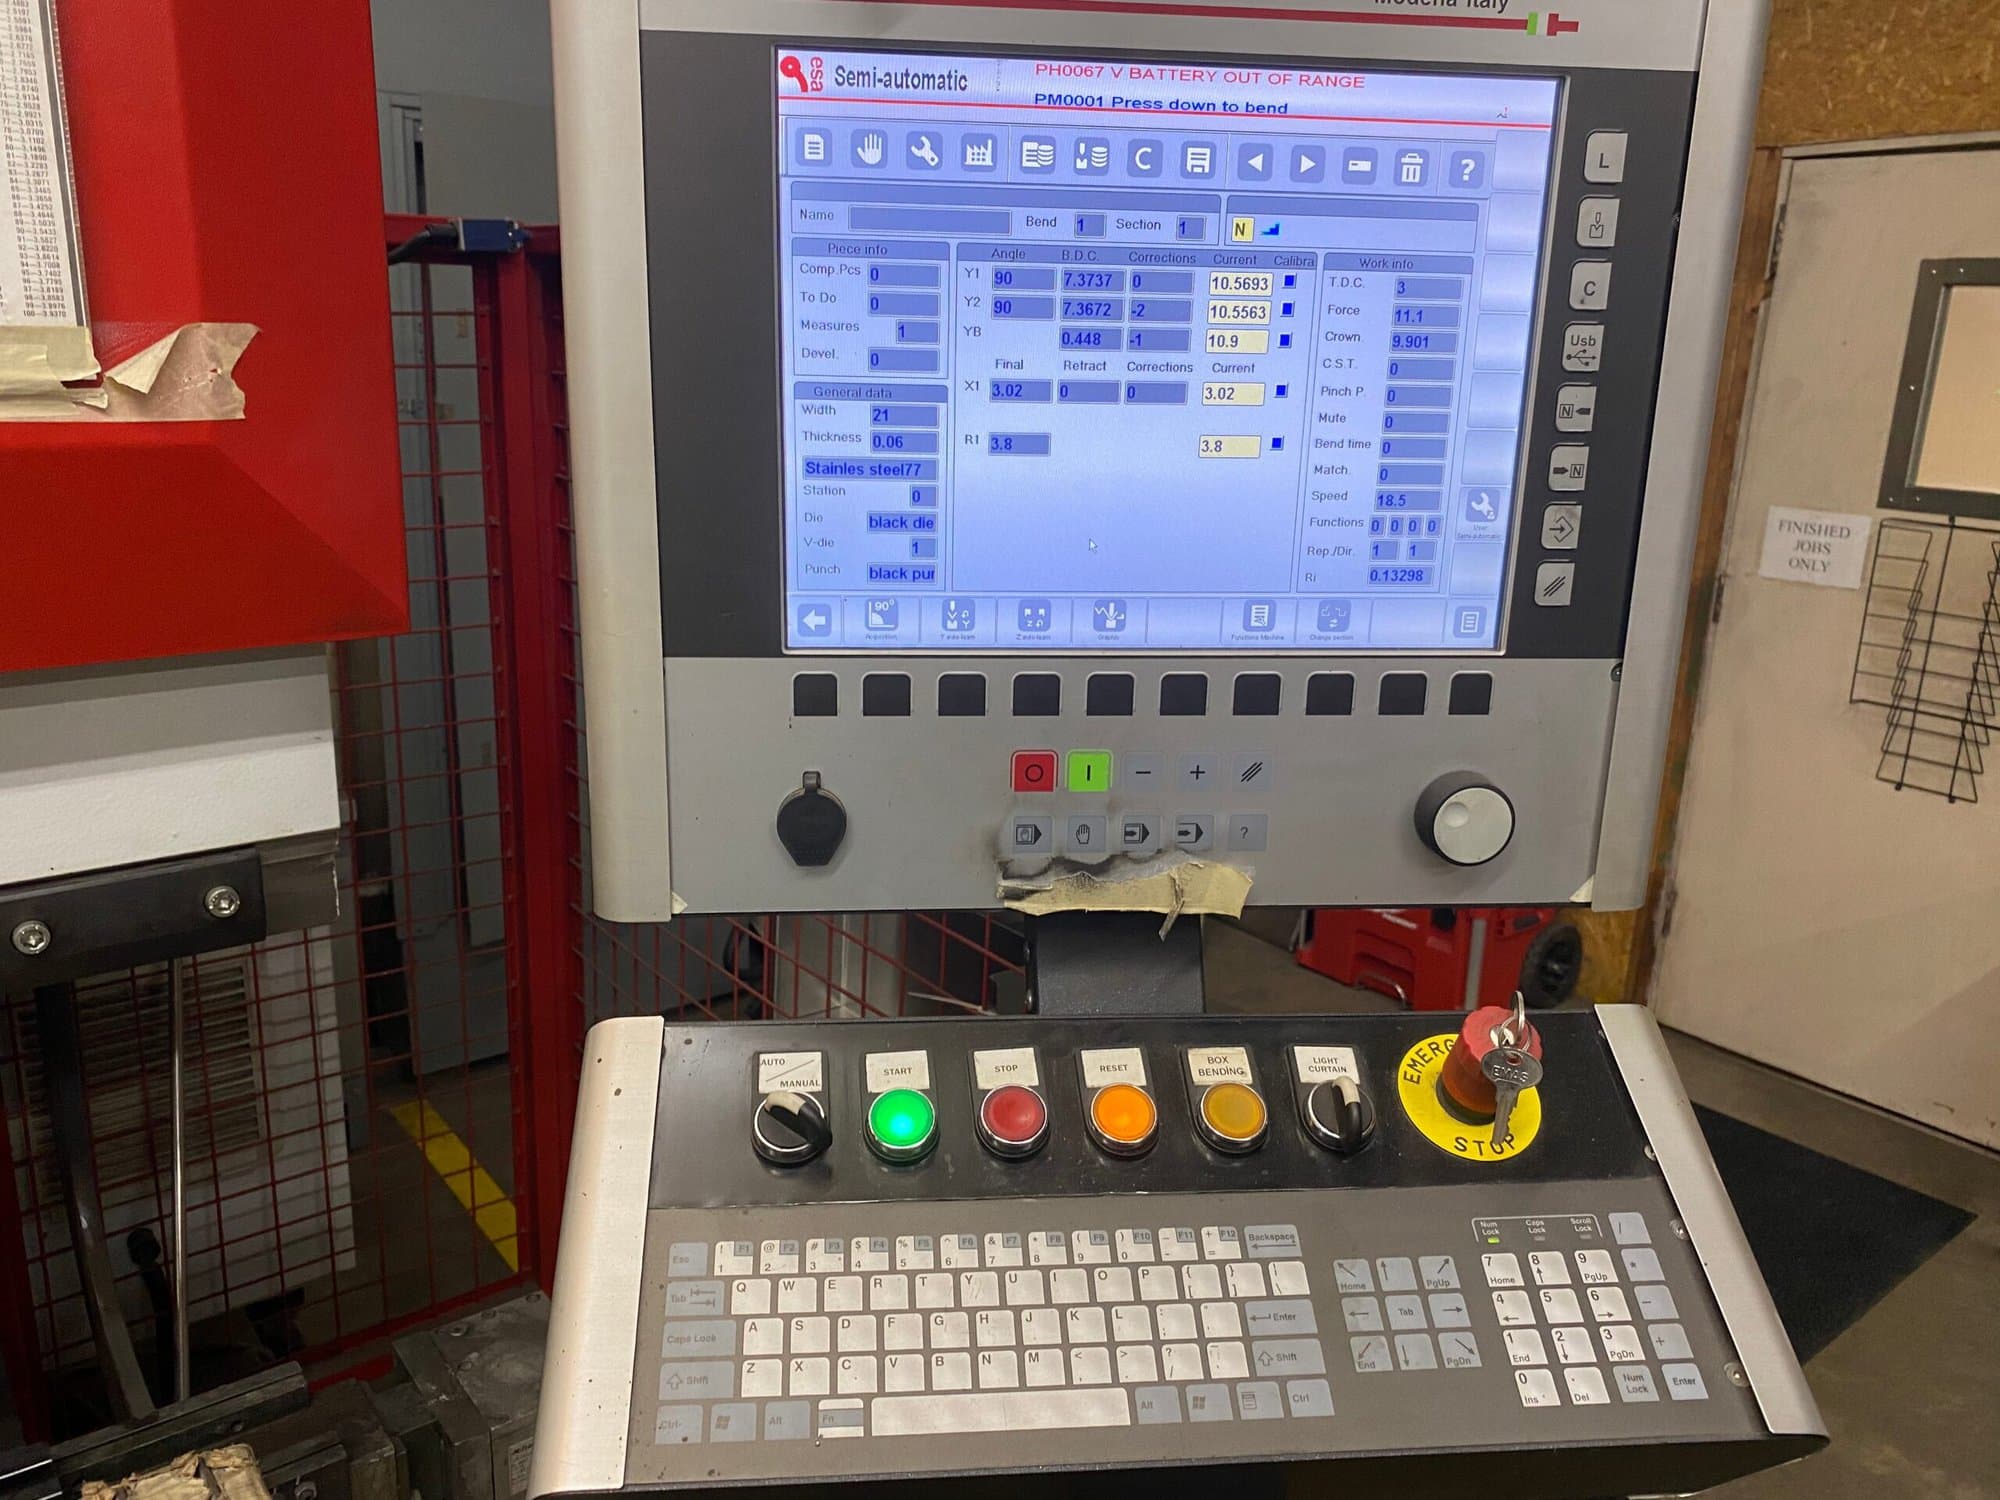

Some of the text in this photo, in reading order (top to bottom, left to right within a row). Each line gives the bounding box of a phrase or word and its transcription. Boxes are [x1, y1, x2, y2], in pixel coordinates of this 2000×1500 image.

[810, 56, 823, 92] esa
[835, 65, 968, 91] Semi-automatic
[1036, 64, 1365, 88] PH0067 V BATTERY OUT OF RANGE
[1035, 93, 1287, 115] PM0001 Press down to bend
[1599, 153, 1610, 169] L
[800, 209, 834, 221] Name
[1026, 216, 1056, 228] Bend
[1077, 218, 1085, 233] 1
[1116, 218, 1161, 231] Section
[1179, 222, 1186, 235] 1
[1235, 224, 1245, 237] N
[828, 243, 887, 255] Piece info
[991, 248, 1025, 260] Angle
[1128, 251, 1196, 265] Corrections
[1214, 254, 1257, 265] Current
[1274, 256, 1315, 267] Calibra
[1359, 258, 1413, 269] Work info
[870, 268, 879, 281] 0
[965, 267, 980, 279] Y1
[994, 271, 1012, 285] 90
[1065, 272, 1112, 287] 7.3737
[1133, 274, 1141, 288] 0
[1212, 276, 1268, 290] 10.5693
[1397, 281, 1405, 294] 3
[1584, 281, 1596, 296] C
[801, 292, 836, 303] To Do
[870, 297, 879, 310] 0
[964, 297, 981, 308] Y2
[994, 300, 1011, 314] 90
[1064, 302, 1111, 316] 7.3672
[1132, 304, 1145, 317] -2
[1210, 305, 1266, 319] 10.5563
[1328, 304, 1360, 315] Force
[1395, 309, 1423, 322] 11.1
[801, 320, 859, 332] Measures
[899, 325, 905, 338] 1
[963, 326, 981, 337] YB
[1062, 332, 1101, 345] 0.448
[1129, 333, 1141, 346] -1
[1209, 335, 1238, 348] 10.9
[1392, 335, 1429, 349] 9.901
[1570, 335, 1596, 347] Usb
[871, 353, 879, 366] 0
[995, 359, 1024, 370] Final
[1064, 360, 1107, 371] Retract
[1127, 362, 1193, 373] Corrections
[1212, 362, 1255, 373] Current
[1390, 363, 1398, 375] 0
[965, 380, 979, 391] X1
[992, 384, 1022, 397] 3.02
[1060, 385, 1068, 398] 0
[1321, 386, 1351, 397] Pinch
[814, 387, 892, 398] General data
[1127, 386, 1135, 399] 0
[1205, 387, 1235, 400] 3.02
[1387, 390, 1396, 402] 0
[802, 404, 836, 416] Width
[873, 409, 889, 422] 21
[1562, 406, 1571, 417] N
[1319, 413, 1346, 423] Mute
[1385, 416, 1393, 428] 0
[802, 431, 861, 443] Thickness
[873, 436, 903, 448] 0.06
[965, 434, 979, 444] R1
[991, 437, 1012, 451] 3.8
[1201, 440, 1222, 452] 3.8
[1315, 439, 1371, 449] Bend time
[1382, 442, 1390, 454] 0
[806, 461, 921, 476] Stainles steel77
[1380, 468, 1388, 480] 0
[1573, 466, 1581, 476] N
[803, 485, 846, 496] Station
[912, 491, 920, 503] 0
[1312, 491, 1348, 503] Speed
[1377, 495, 1406, 506] 18.5
[804, 512, 823, 522] Die
[869, 515, 933, 529] black die
[1310, 517, 1364, 528] Functions
[1371, 520, 1379, 532] 0
[1391, 520, 1399, 532] 0
[1408, 520, 1416, 532] 0
[1427, 520, 1436, 532] 0
[1778, 519, 1851, 539] FINISHED
[804, 538, 834, 547] V-die
[912, 542, 918, 553] 1
[1794, 540, 1831, 555] JOBS
[1373, 544, 1379, 556] 1
[1409, 544, 1416, 556] 1
[805, 564, 840, 575] Punch
[1788, 558, 1830, 573] ONLY
[869, 567, 908, 580] black
[1305, 572, 1316, 582] Ri
[1370, 569, 1423, 582] 0.13298
[761, 1058, 786, 1067] AUTO
[1208, 1056, 1228, 1065] BOX
[1312, 1057, 1339, 1065] LIGHT
[1403, 1039, 1455, 1085] EMERG
[884, 1067, 912, 1076] START
[994, 1064, 1018, 1073] STOP
[1100, 1064, 1128, 1073] RESET
[1308, 1064, 1347, 1073] CURTAIN
[1492, 1065, 1529, 1083] EMAS
[780, 1079, 820, 1088] MANUAL
[1454, 1133, 1515, 1156] STOP
[1525, 1219, 1544, 1227] Caps
[1529, 1226, 1546, 1234] Lock
[1249, 1233, 1294, 1242] Backspace
[1584, 1273, 1608, 1282] PgUp
[1273, 1313, 1296, 1321] Enter
[1398, 1308, 1414, 1316] Tab
[1513, 1354, 1530, 1363] End
[1610, 1351, 1634, 1359] PgDn
[1623, 1374, 1644, 1382] Num
[1673, 1377, 1696, 1386] Enter
[1627, 1385, 1648, 1393] Lock
[1574, 1393, 1589, 1401] Del
